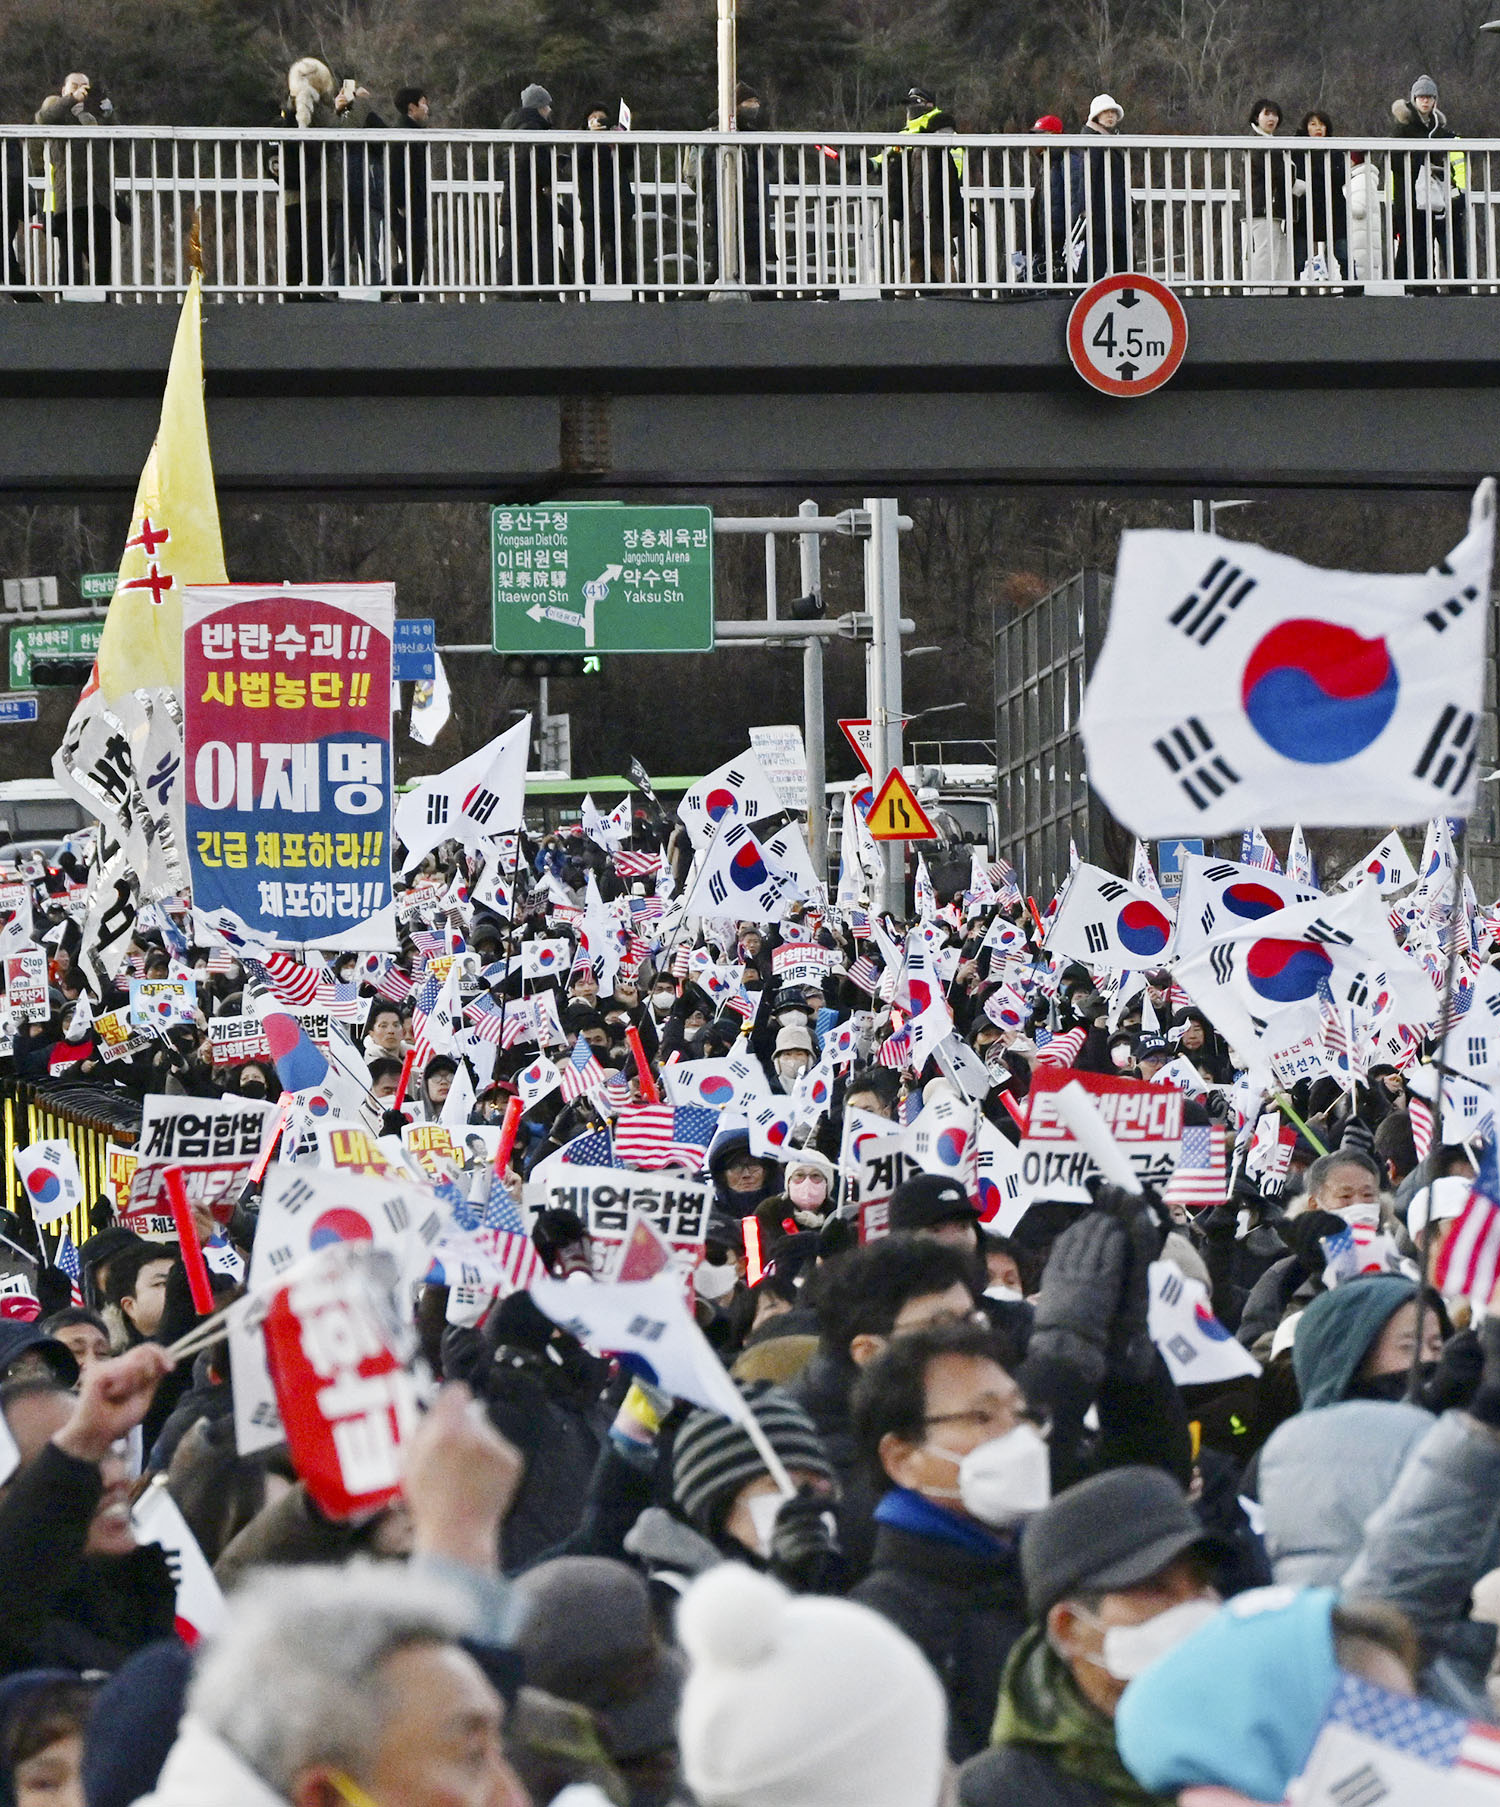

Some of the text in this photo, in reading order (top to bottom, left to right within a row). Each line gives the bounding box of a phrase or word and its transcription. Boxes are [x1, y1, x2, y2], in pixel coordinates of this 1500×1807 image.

[1092, 312, 1164, 358] 4.5m
[497, 512, 568, 531] 용산구청
[497, 533, 568, 548] Yongsan Dist Ofc
[623, 528, 708, 549] 장충체육관
[497, 550, 568, 569] 이태원역
[623, 551, 690, 566] Jangchung Arena
[623, 568, 679, 588] 약수역
[498, 590, 569, 603] Itaewon Stn
[588, 584, 606, 597] 41
[624, 590, 684, 604] Yaksu Stn
[201, 623, 371, 660] 반란수괴!!
[201, 671, 371, 709] 사법농단!!
[195, 740, 384, 815] 이재명
[196, 831, 384, 869] 긴급 체포하라!!
[257, 880, 384, 919] 체포하라!!
[23, 957, 43, 969] Stop
[781, 966, 807, 981] 재명
[211, 1019, 264, 1040] 계엄합
[145, 1112, 265, 1158] 계엄합법
